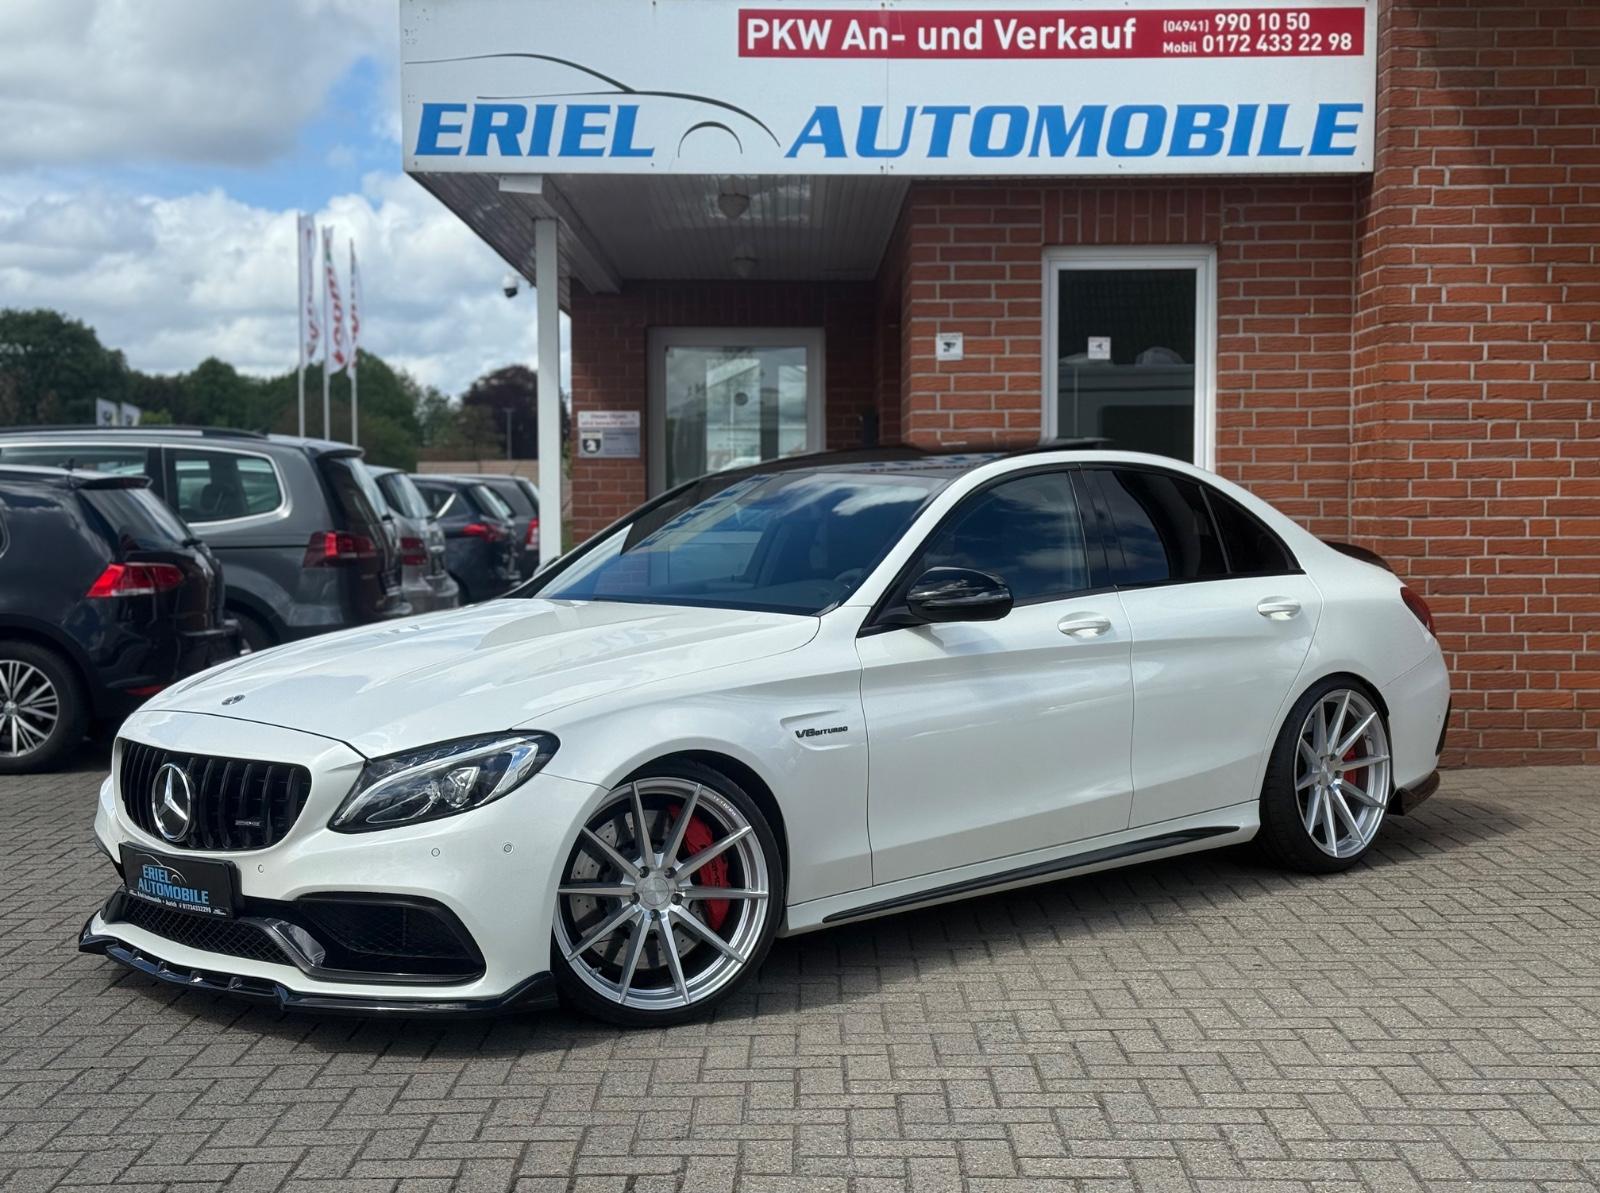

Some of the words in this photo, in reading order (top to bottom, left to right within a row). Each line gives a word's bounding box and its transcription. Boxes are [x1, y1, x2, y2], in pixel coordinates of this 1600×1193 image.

[1164, 20, 1209, 32] (04941)
[1215, 13, 1250, 31] 990
[1258, 13, 1280, 30] 10
[1287, 12, 1310, 30] 50
[748, 19, 832, 50] PKW
[841, 19, 905, 50] An-
[918, 19, 982, 50] und
[994, 18, 1136, 50] Verkauf
[1163, 42, 1196, 53] Mobil
[1203, 34, 1250, 52] 0172
[1256, 34, 1292, 51] 433
[1299, 33, 1322, 51] 22
[1328, 33, 1351, 50] 98
[415, 102, 655, 159] ERIEL
[785, 102, 1364, 159] AUTOMOBILE
[142, 866, 172, 884] ERIEL
[138, 878, 209, 904] AUTOMOBILE
